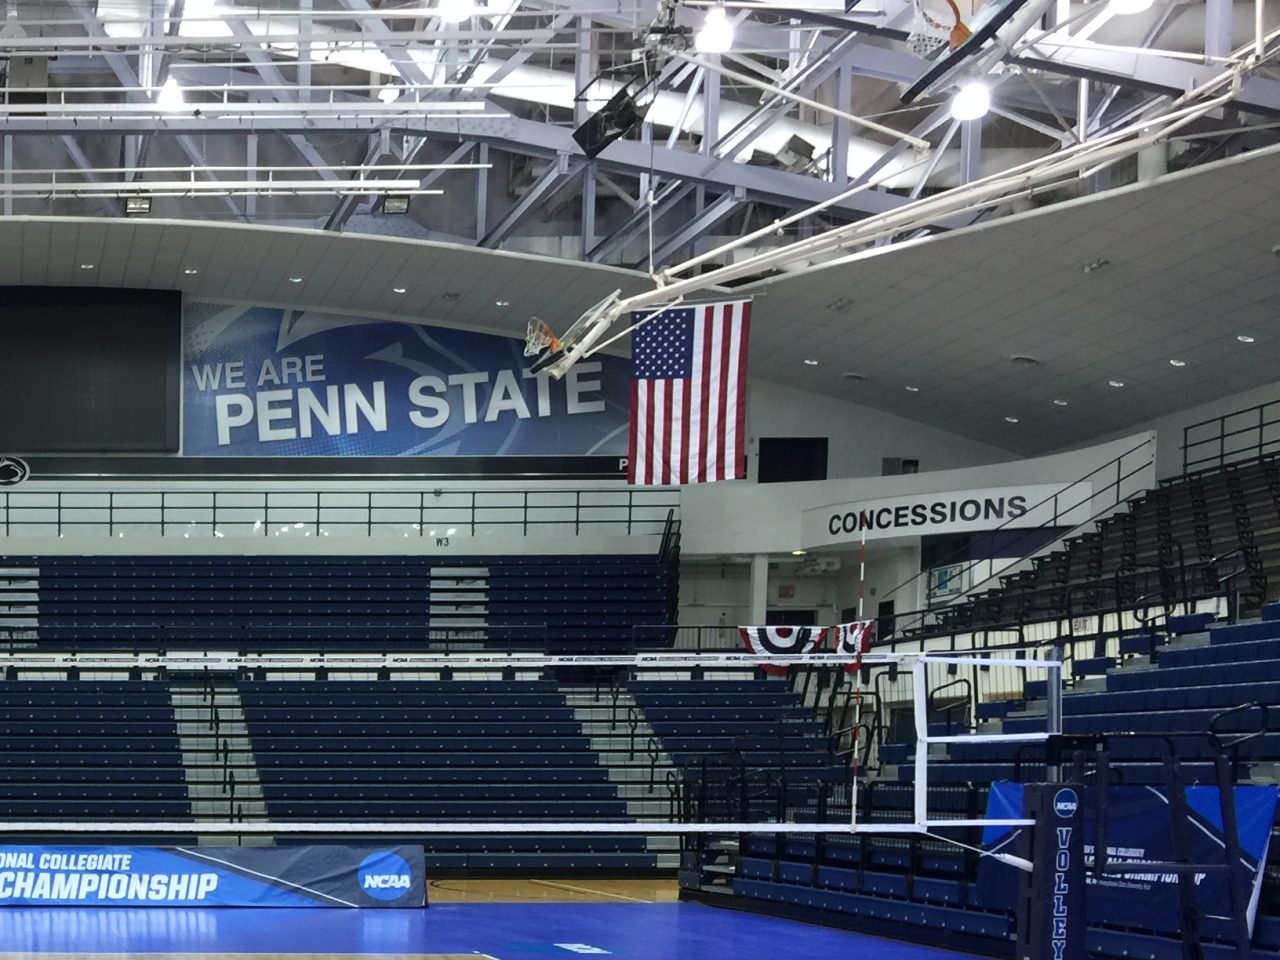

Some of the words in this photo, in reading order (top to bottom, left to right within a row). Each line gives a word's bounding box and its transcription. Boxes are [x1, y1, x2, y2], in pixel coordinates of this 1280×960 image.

[192, 362, 246, 391] WE
[257, 354, 326, 386] ARE
[216, 381, 388, 445] PENN
[408, 362, 606, 427] STATE
[828, 496, 1027, 535] CONCESSIONS
[436, 537, 449, 547] W3
[1056, 802, 1077, 810] NCAA
[39, 854, 132, 870] COLLEGIATE
[364, 874, 410, 888] NCAA
